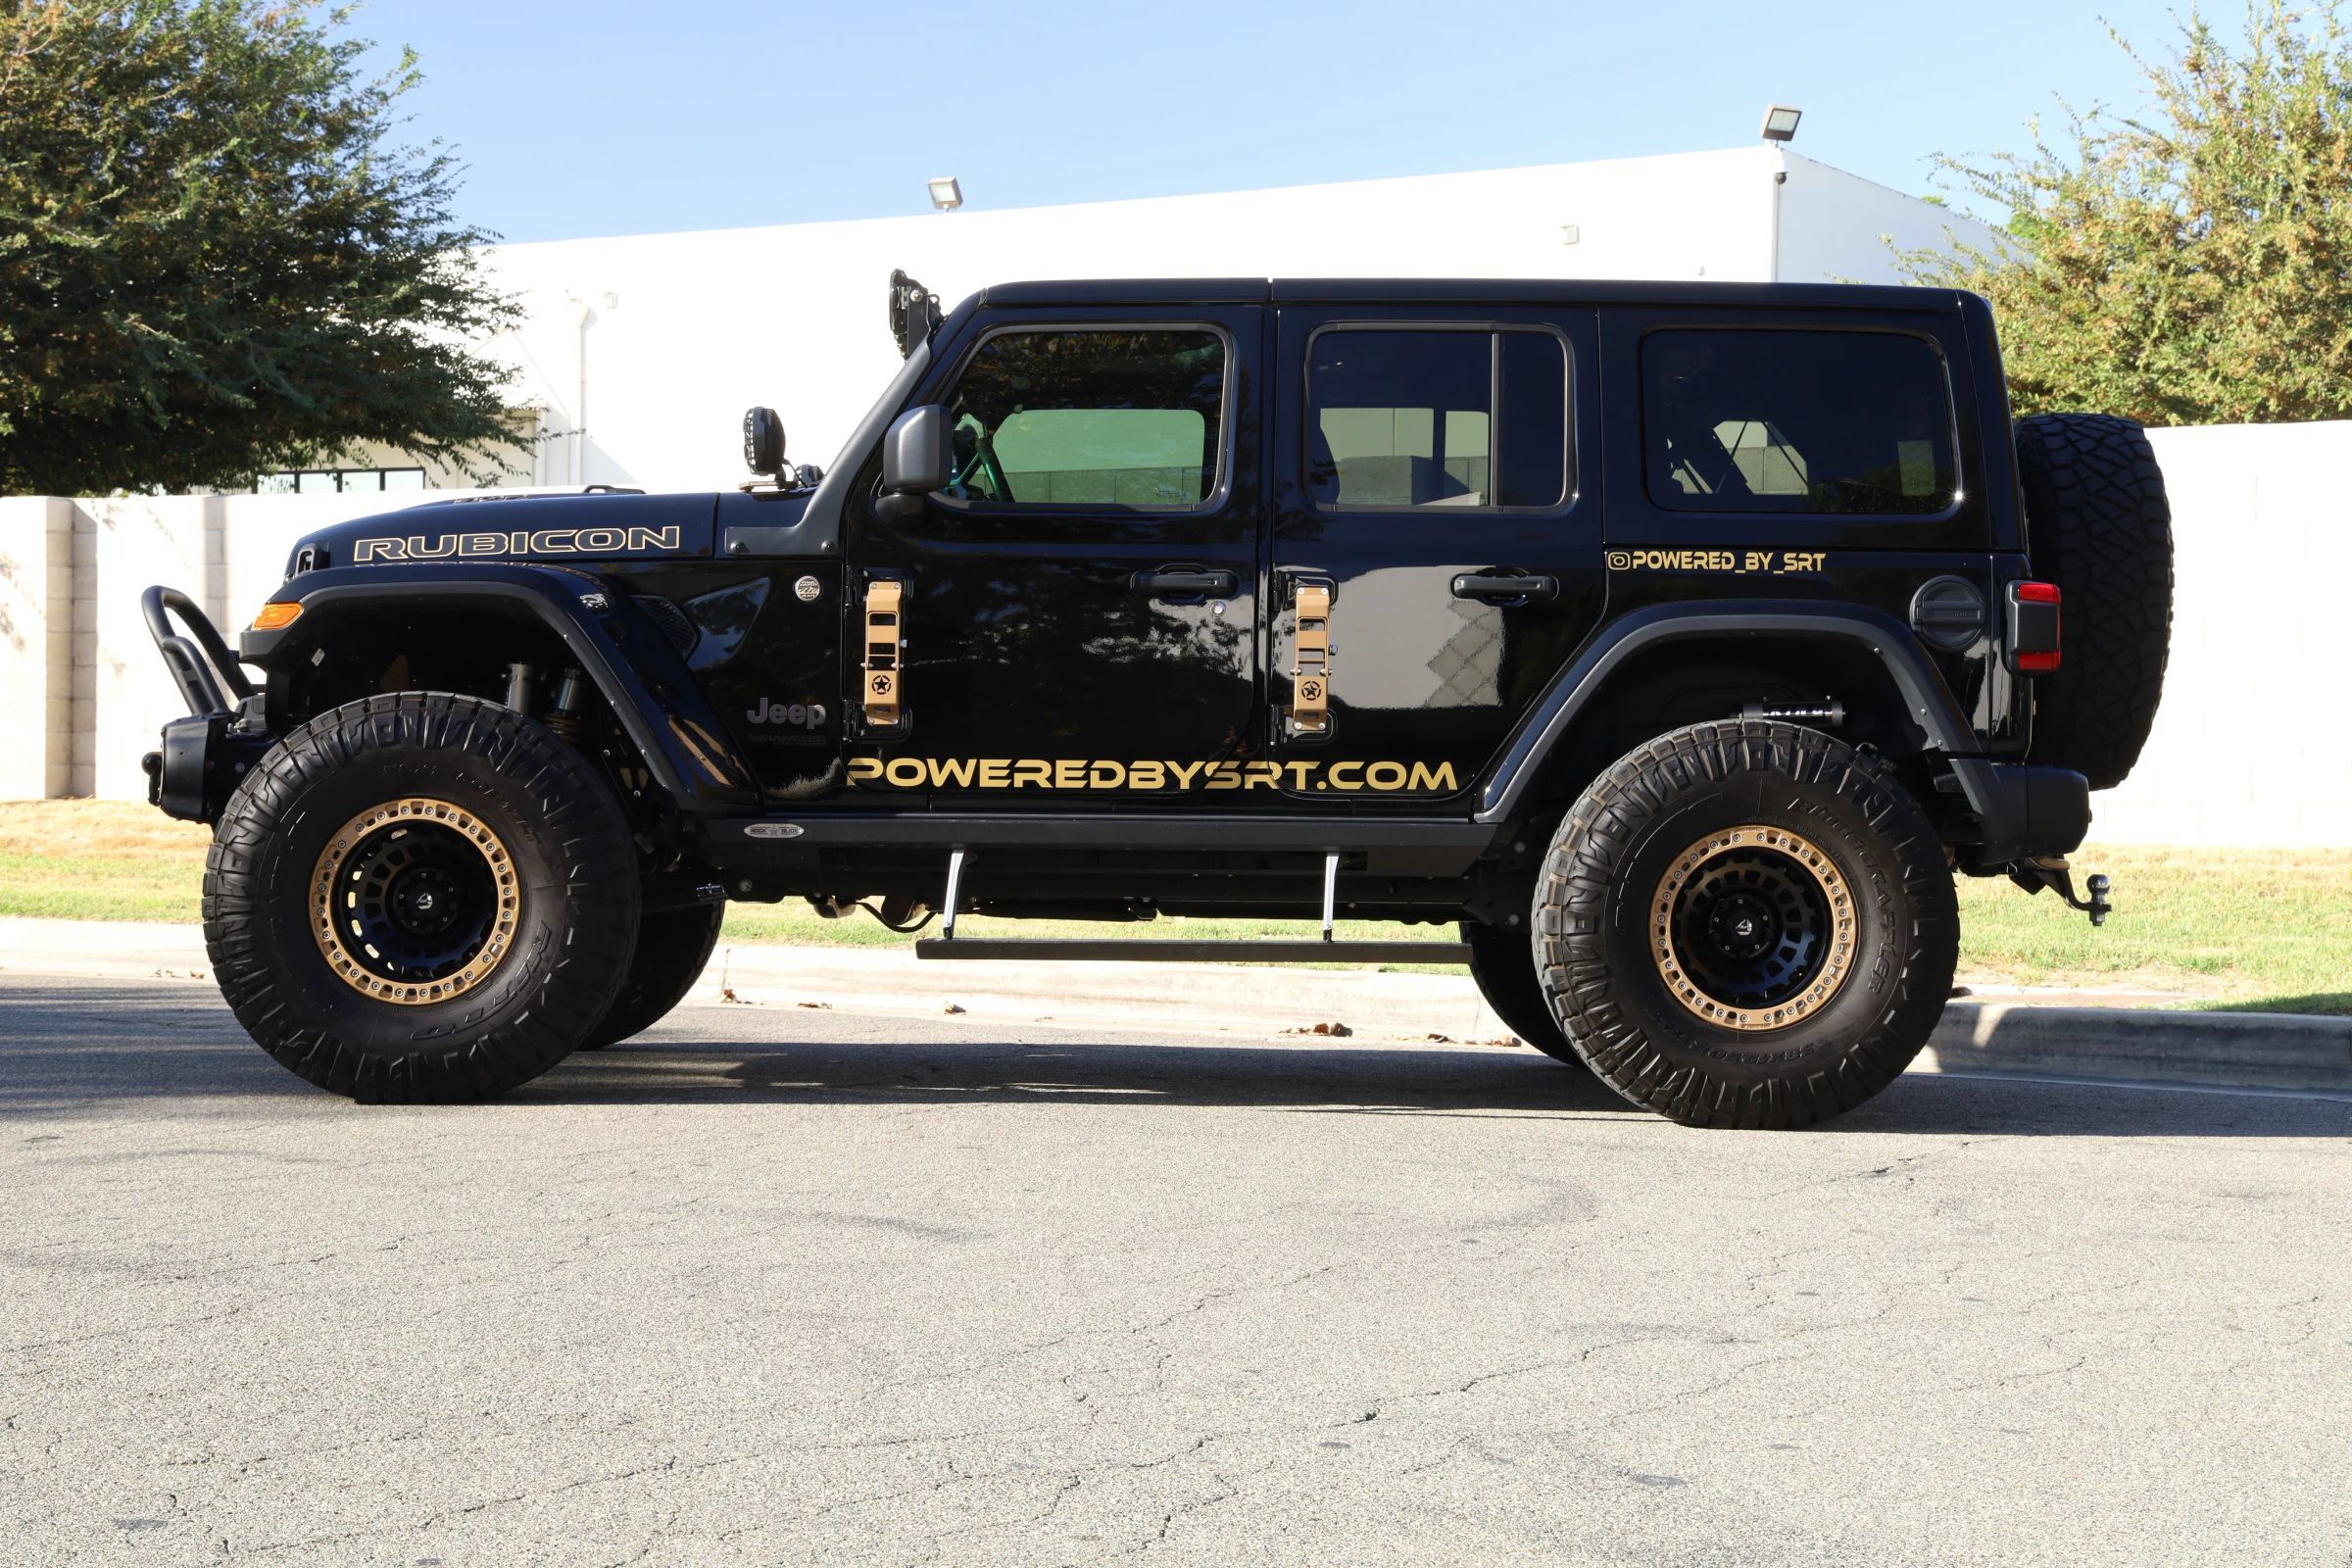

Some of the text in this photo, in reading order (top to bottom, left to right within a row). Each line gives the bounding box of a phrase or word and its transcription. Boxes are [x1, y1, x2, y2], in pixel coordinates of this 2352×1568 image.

[354, 525, 680, 562] RUBICON
[1633, 551, 1827, 574] POWERED_BY_SRT
[746, 697, 827, 730] Jeep
[846, 757, 1459, 791] POWEREDBYSRT.COM
